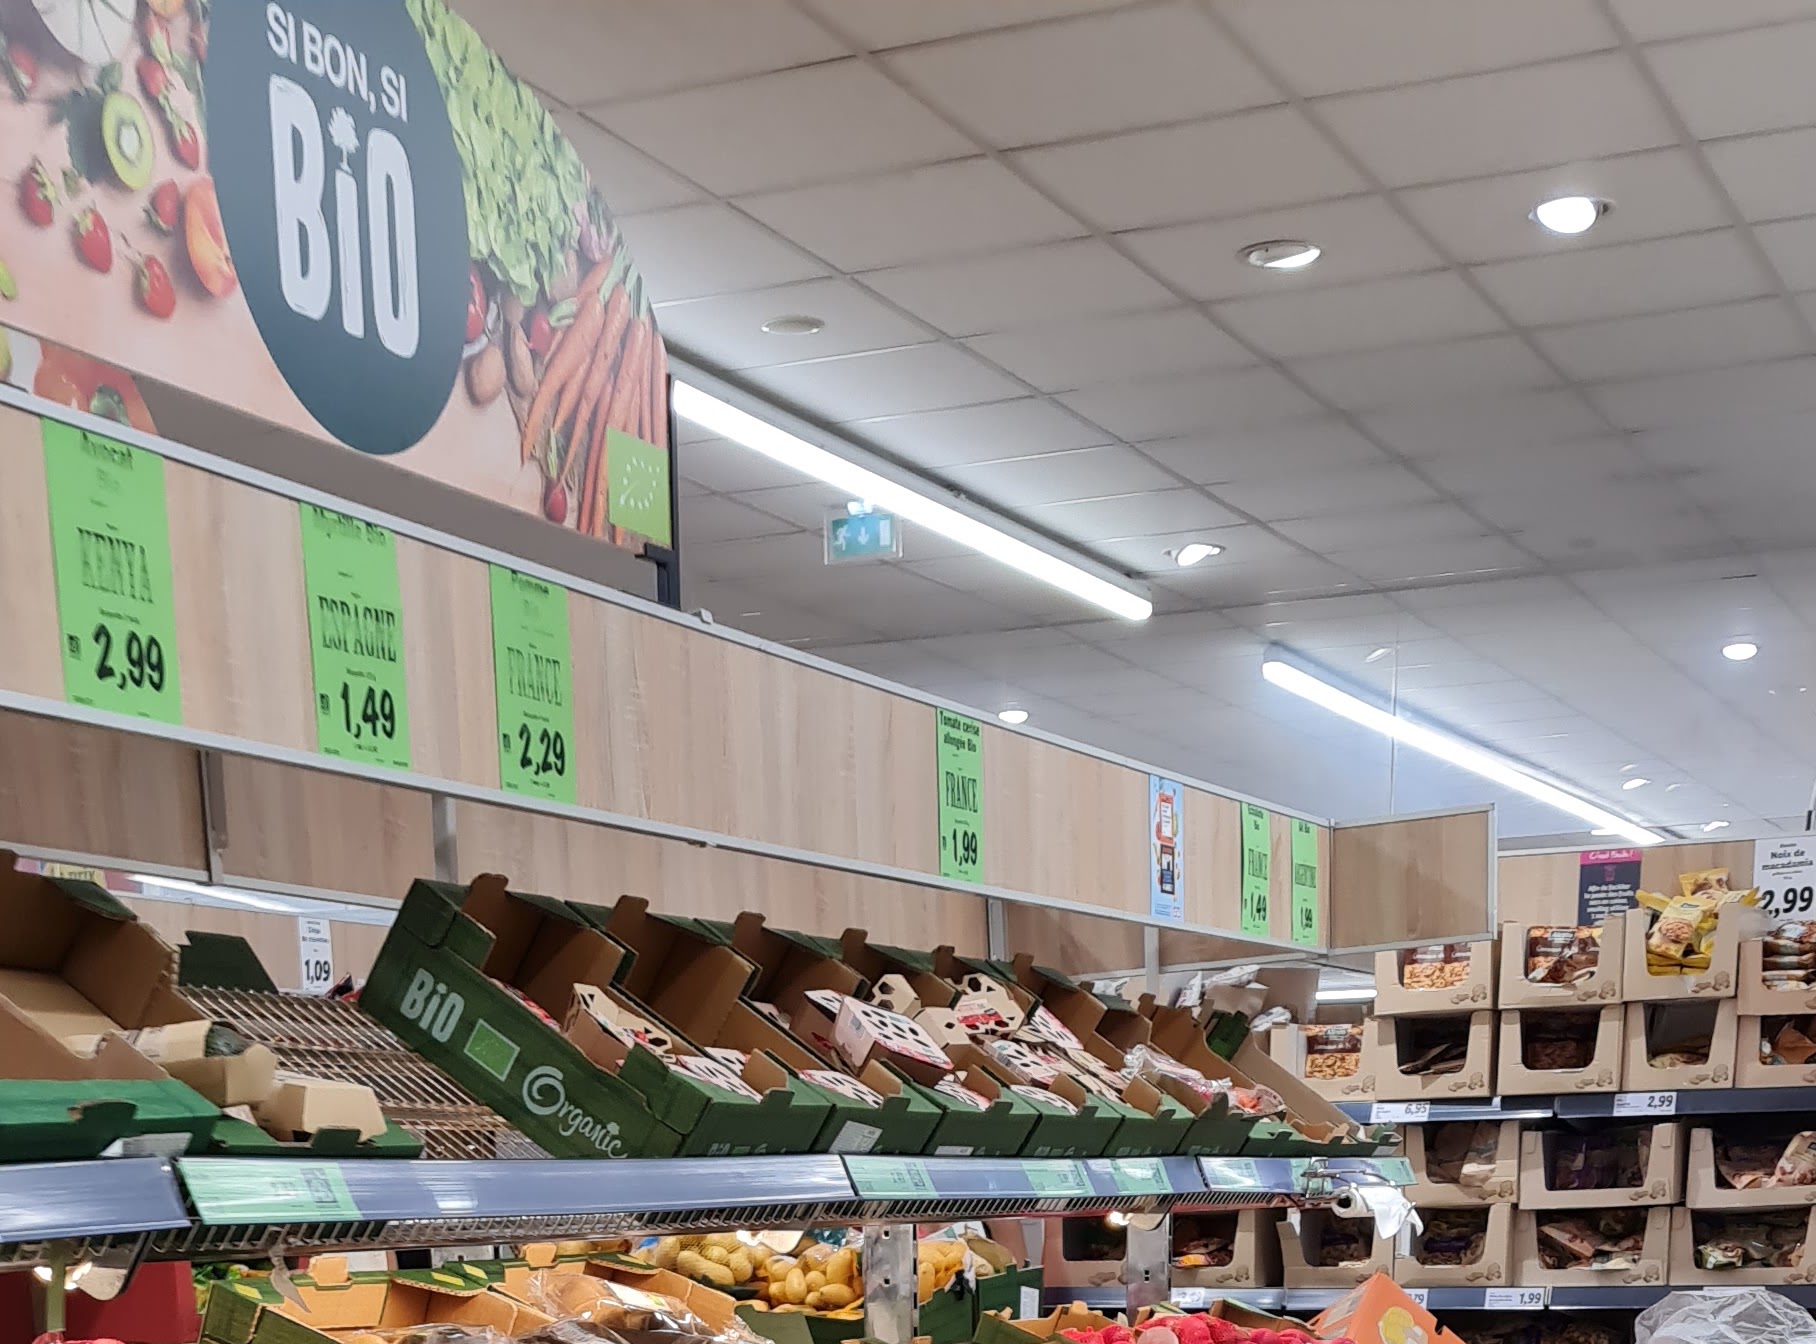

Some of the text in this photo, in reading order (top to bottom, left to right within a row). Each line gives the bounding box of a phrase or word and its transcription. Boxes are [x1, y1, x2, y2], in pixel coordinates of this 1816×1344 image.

[267, 2, 408, 122] SI BON, SI
[317, 595, 397, 663] ESPAGNE
[92, 623, 165, 693] 2,99
[507, 646, 563, 707] FRANCE
[340, 681, 396, 740] 1,49
[518, 722, 566, 777] 2,29
[945, 771, 978, 813] FRANCE
[952, 828, 978, 866] 1,99
[1770, 849, 1805, 859] Noix de
[1250, 892, 1267, 922] 1,49
[1759, 886, 1814, 918] 2,99
[304, 959, 331, 984] 1,09
[522, 1066, 628, 1159] Organic
[1647, 1094, 1674, 1109] 2,99
[1519, 1293, 1542, 1304] 1,99
